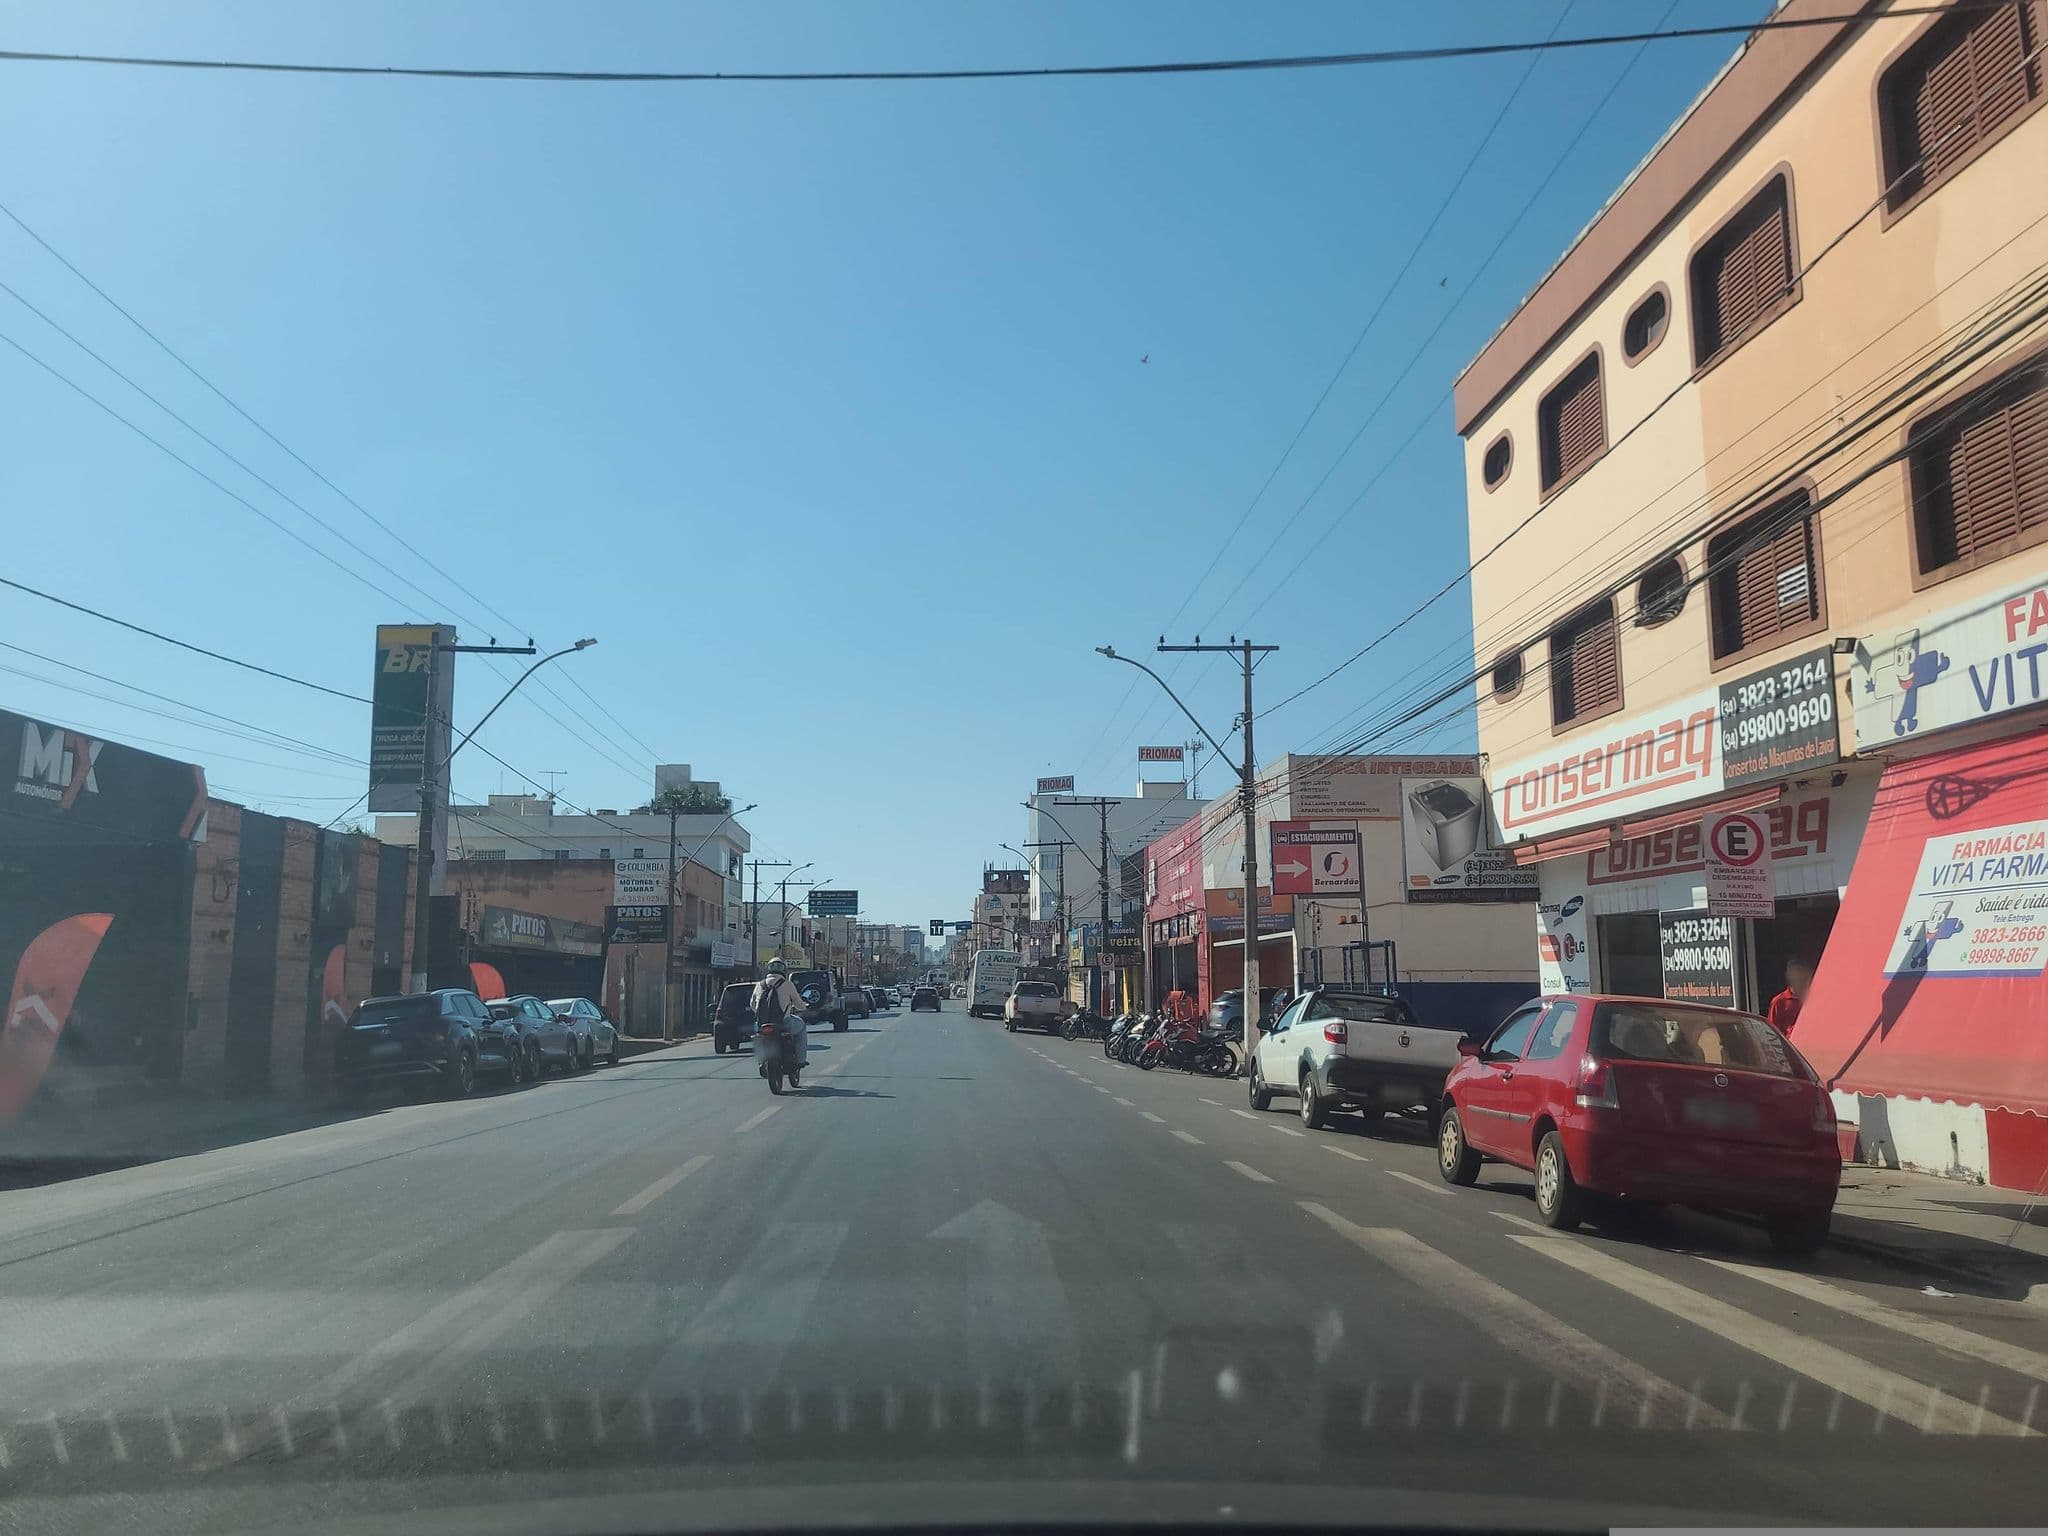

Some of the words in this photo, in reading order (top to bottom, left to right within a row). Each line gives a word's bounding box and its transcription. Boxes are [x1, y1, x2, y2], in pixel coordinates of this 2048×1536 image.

[1721, 696, 1737, 719] (34)
[1722, 728, 1738, 752] (34)
[1140, 749, 1182, 760] FRIOMAQ
[1724, 756, 1758, 779] Conserto
[1759, 753, 1768, 770] de
[1805, 740, 1815, 757] de
[1815, 736, 1836, 756] Lavar
[1370, 761, 1475, 775] INTEGRADA
[1038, 778, 1072, 790] FRIOMAQ
[1291, 832, 1354, 842] ESTACIONAMENTO
[1727, 825, 1748, 856] E
[1952, 831, 2045, 861] FARMÁCIA
[627, 862, 665, 872] COLUMBIA
[1932, 861, 1974, 887] VITA
[617, 907, 662, 917] PATOS
[1975, 896, 2012, 913] Saúde
[2013, 895, 2022, 910] é
[512, 914, 546, 937] PATOS
[1993, 914, 2006, 923] Tele
[2008, 914, 2034, 923] Entrega
[1087, 936, 1141, 947] Olveira
[1971, 925, 2047, 944] 3823-2666
[1968, 947, 2039, 964] 99898-8667
[1543, 977, 1561, 988] Consul
